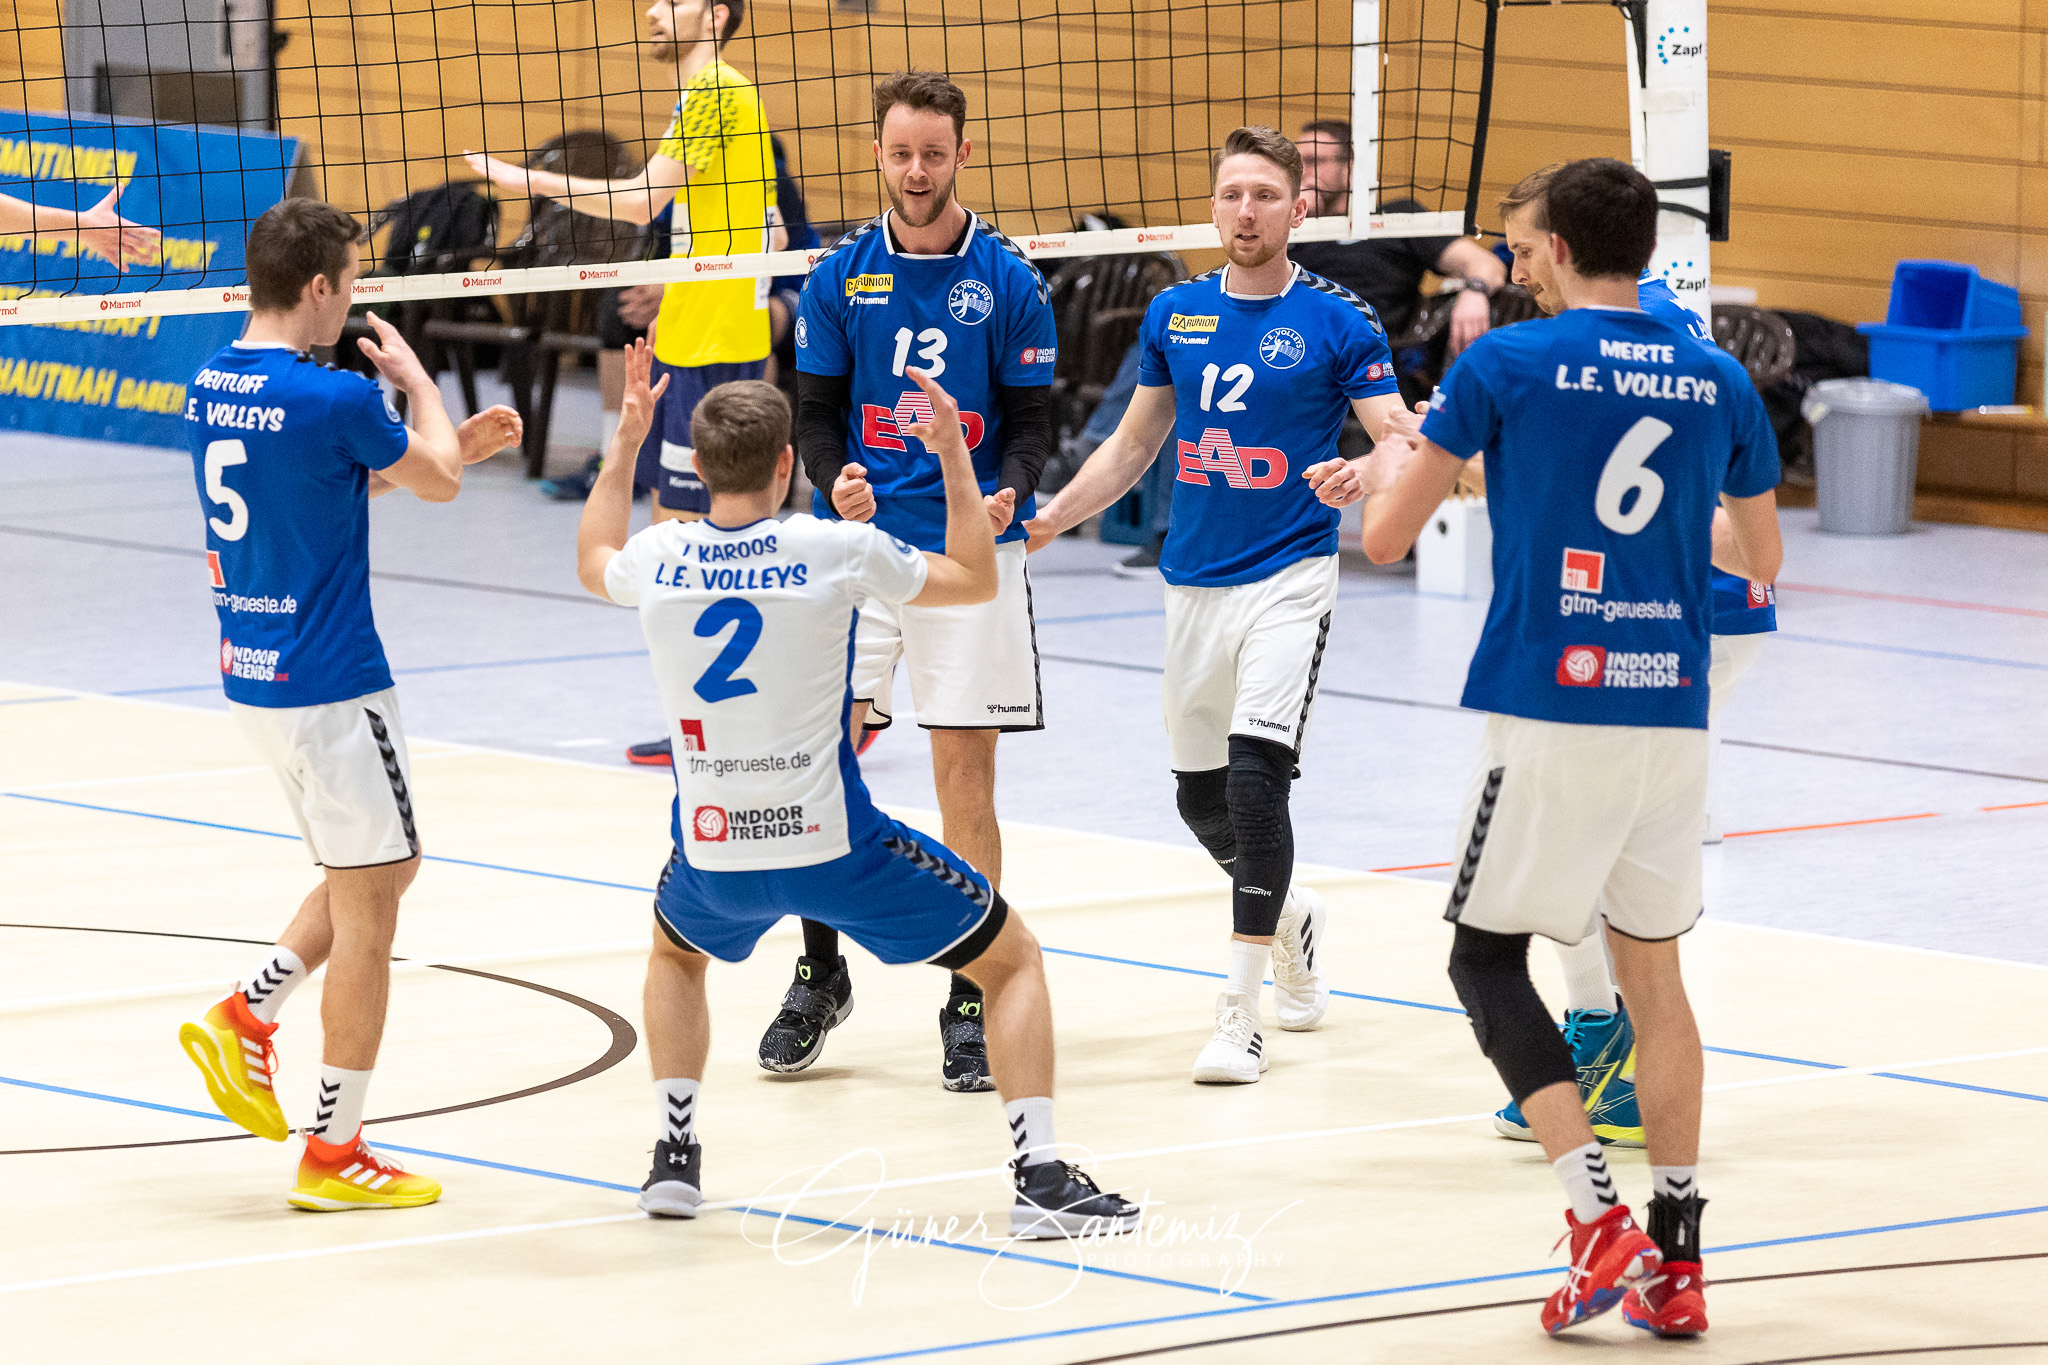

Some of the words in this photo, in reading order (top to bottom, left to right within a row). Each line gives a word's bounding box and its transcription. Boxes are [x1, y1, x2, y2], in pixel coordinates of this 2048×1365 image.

[1037, 239, 1066, 250] Marmot
[1145, 232, 1174, 243] Marmot
[588, 268, 618, 279] Marmot
[703, 262, 733, 271] Marmot
[352, 284, 384, 294] Marmot
[471, 276, 502, 288] Marmot
[960, 281, 991, 302] VOLLEYS
[109, 300, 142, 310] Marmot
[232, 292, 251, 301] Mar
[856, 295, 889, 305] hummel
[1171, 316, 1217, 330] CARUNION
[1179, 335, 1210, 345] hummel
[1275, 329, 1303, 349] VOLLEYS
[892, 326, 949, 379] 13
[1600, 338, 1675, 364] MERTE
[194, 368, 269, 394] DEUTLOFF
[1200, 362, 1255, 413] 12
[1556, 364, 1604, 393] L.E.
[1613, 369, 1718, 406] VOLLEYS
[184, 397, 200, 423] .E.
[206, 401, 286, 432] VOLLEYS
[1176, 427, 1289, 490] EAD
[1594, 415, 1674, 535] 6
[204, 438, 249, 542] 5
[698, 534, 778, 563] KAROOS
[655, 562, 691, 589] L.E.
[700, 563, 808, 591] VOLLEYS
[1560, 593, 1683, 623] gtm-gerueste.de
[231, 645, 280, 667] NDOOR
[692, 597, 763, 704] 2
[1605, 652, 1681, 671] INDOOR
[997, 703, 1031, 714] hummel
[1256, 718, 1291, 733] hummel
[688, 751, 812, 778] tm-gerueste.de
[729, 805, 804, 826] INDOOR
